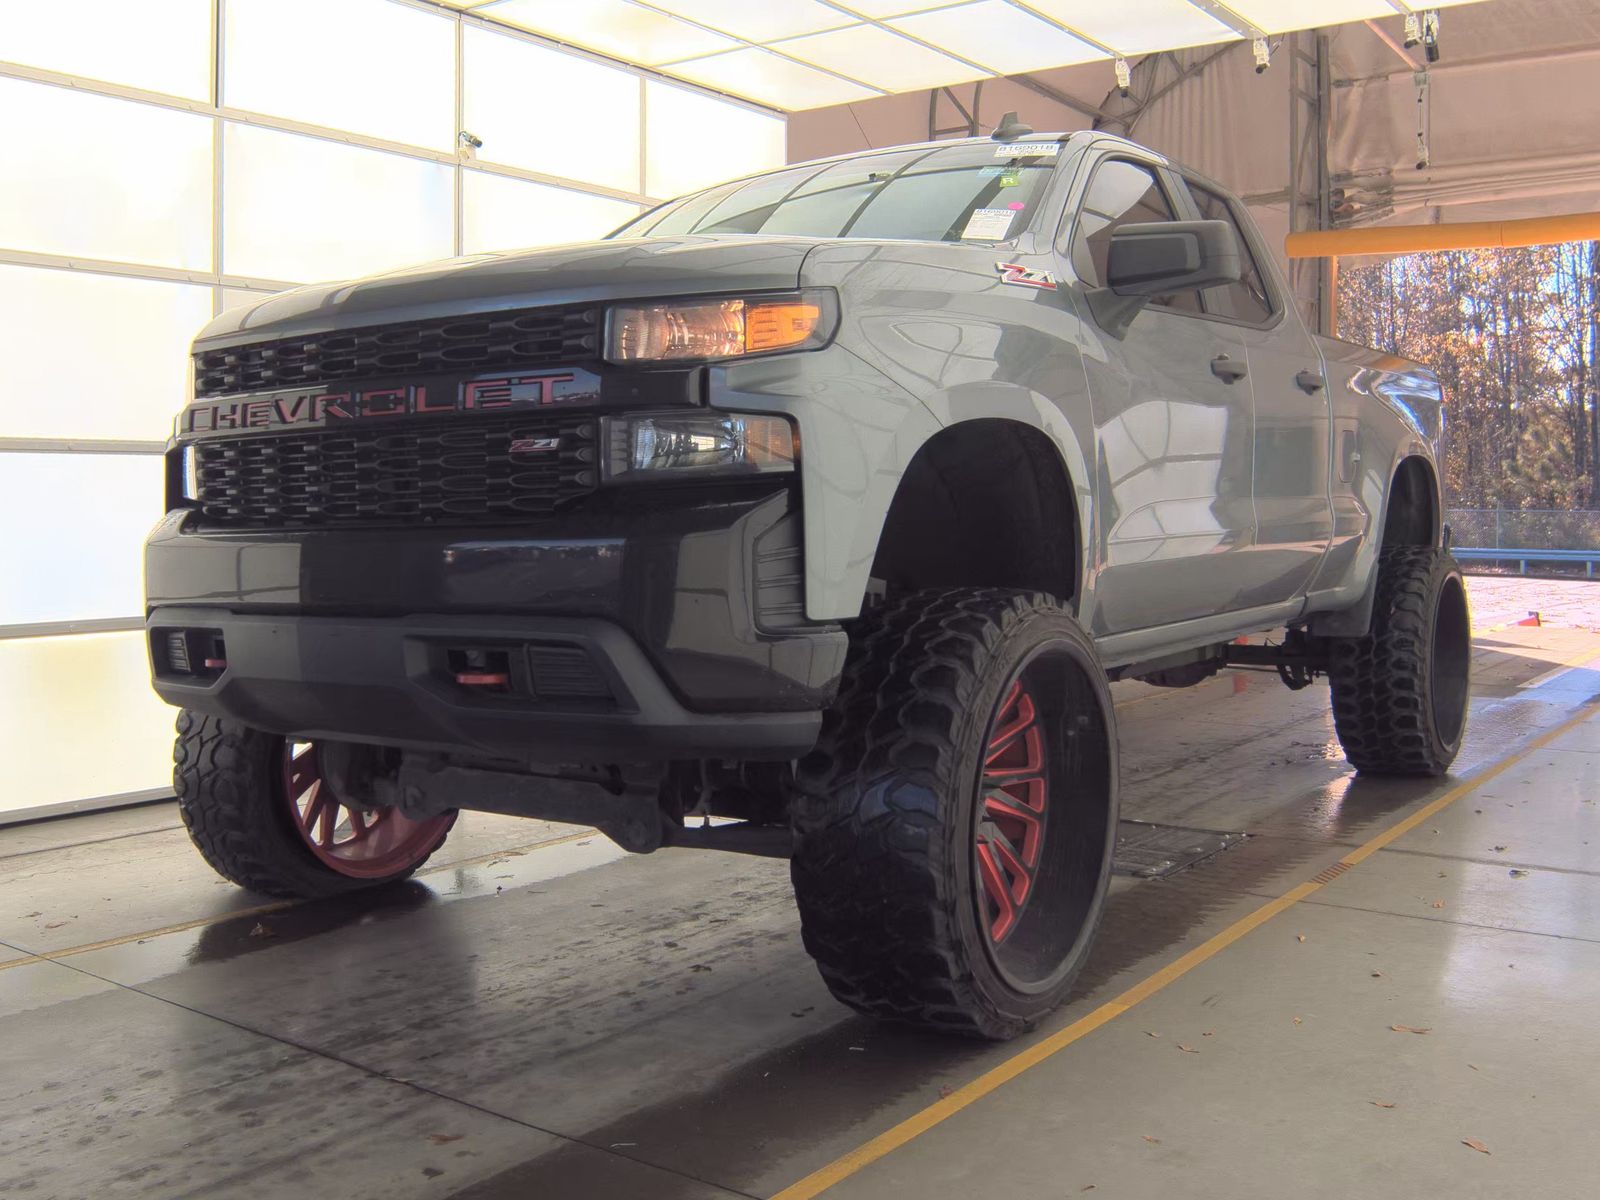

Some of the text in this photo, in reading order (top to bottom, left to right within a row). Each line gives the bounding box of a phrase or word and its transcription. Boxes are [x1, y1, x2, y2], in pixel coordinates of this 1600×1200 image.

[994, 262, 1057, 291] Z71
[189, 373, 575, 432] CHEVROLET
[509, 438, 560, 452] Z71
